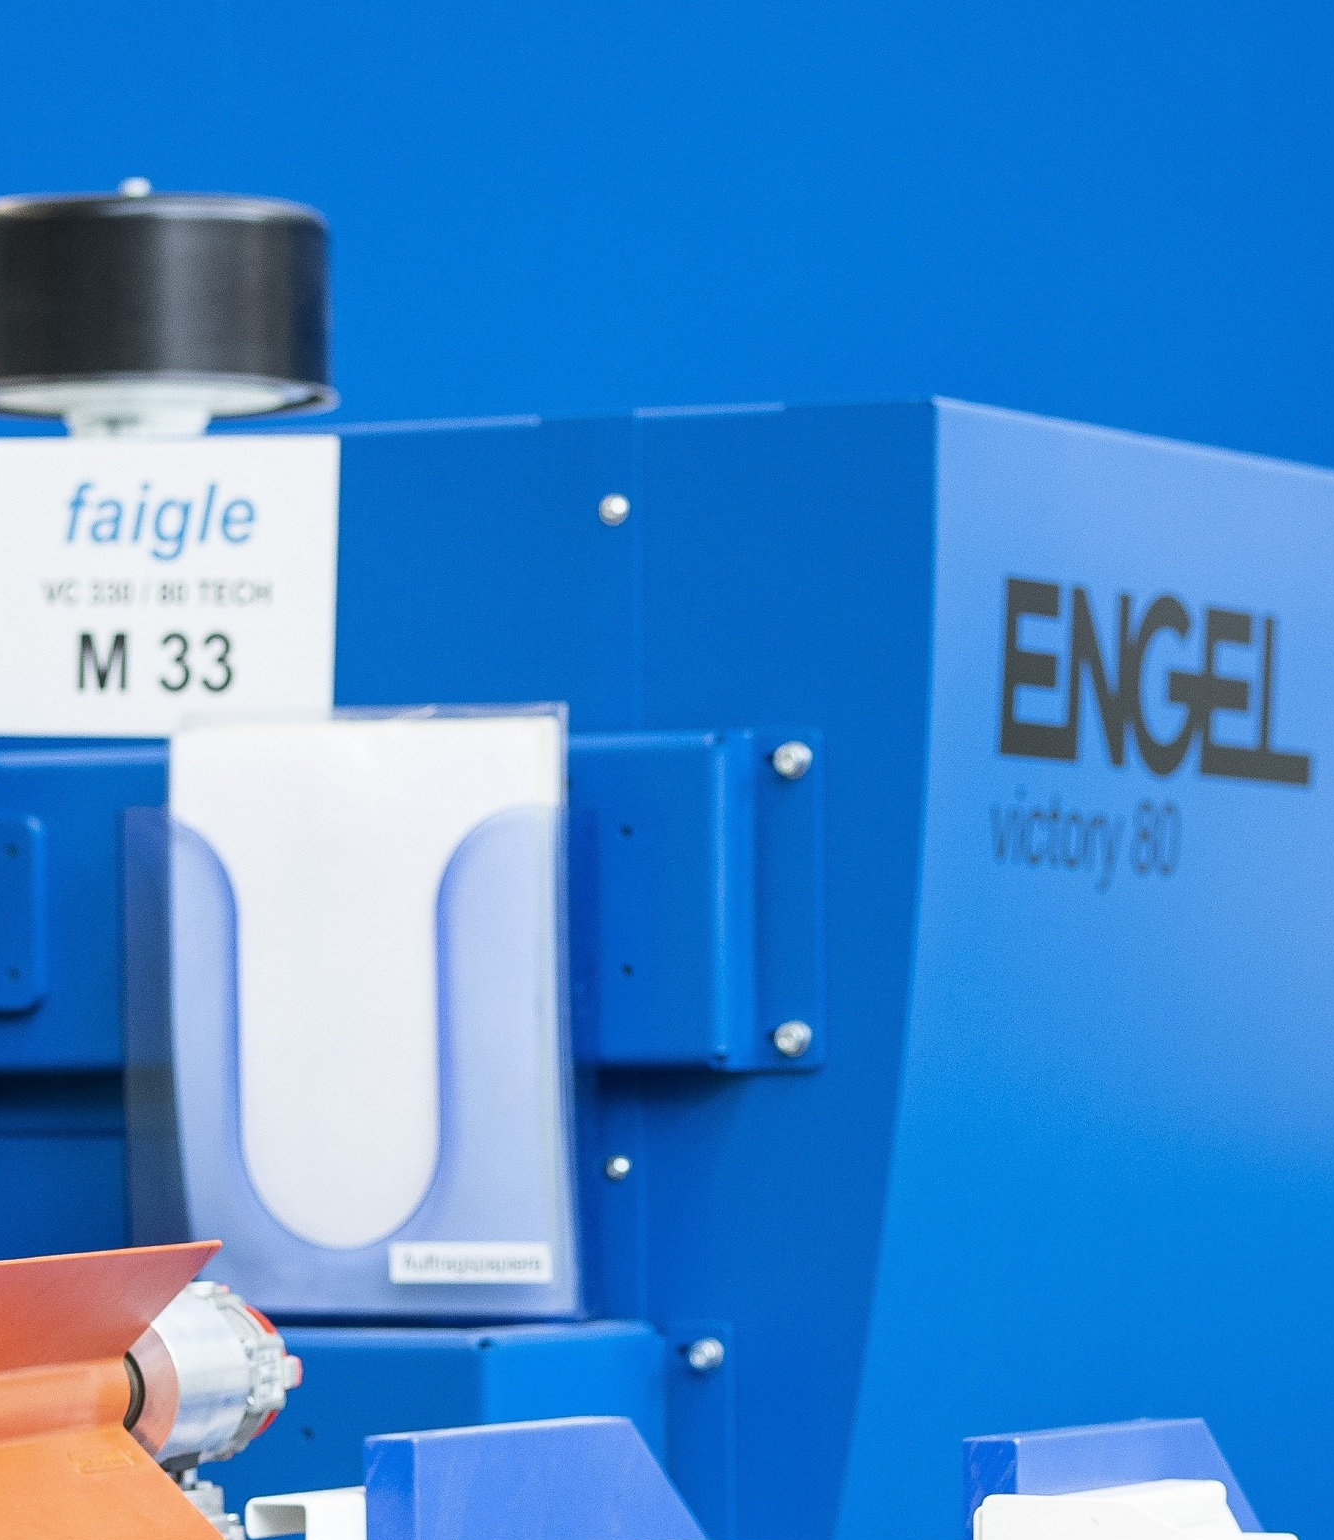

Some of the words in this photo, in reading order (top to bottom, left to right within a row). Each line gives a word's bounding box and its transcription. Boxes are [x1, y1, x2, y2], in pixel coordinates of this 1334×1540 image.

[64, 481, 258, 561] faigle
[42, 578, 80, 607] VC
[157, 578, 188, 607] 80
[198, 578, 275, 607] TECH
[76, 631, 129, 693] M
[159, 631, 236, 694] 33
[999, 577, 1311, 787] ENGEL
[990, 784, 1125, 890] victory
[1132, 800, 1181, 876] 80
